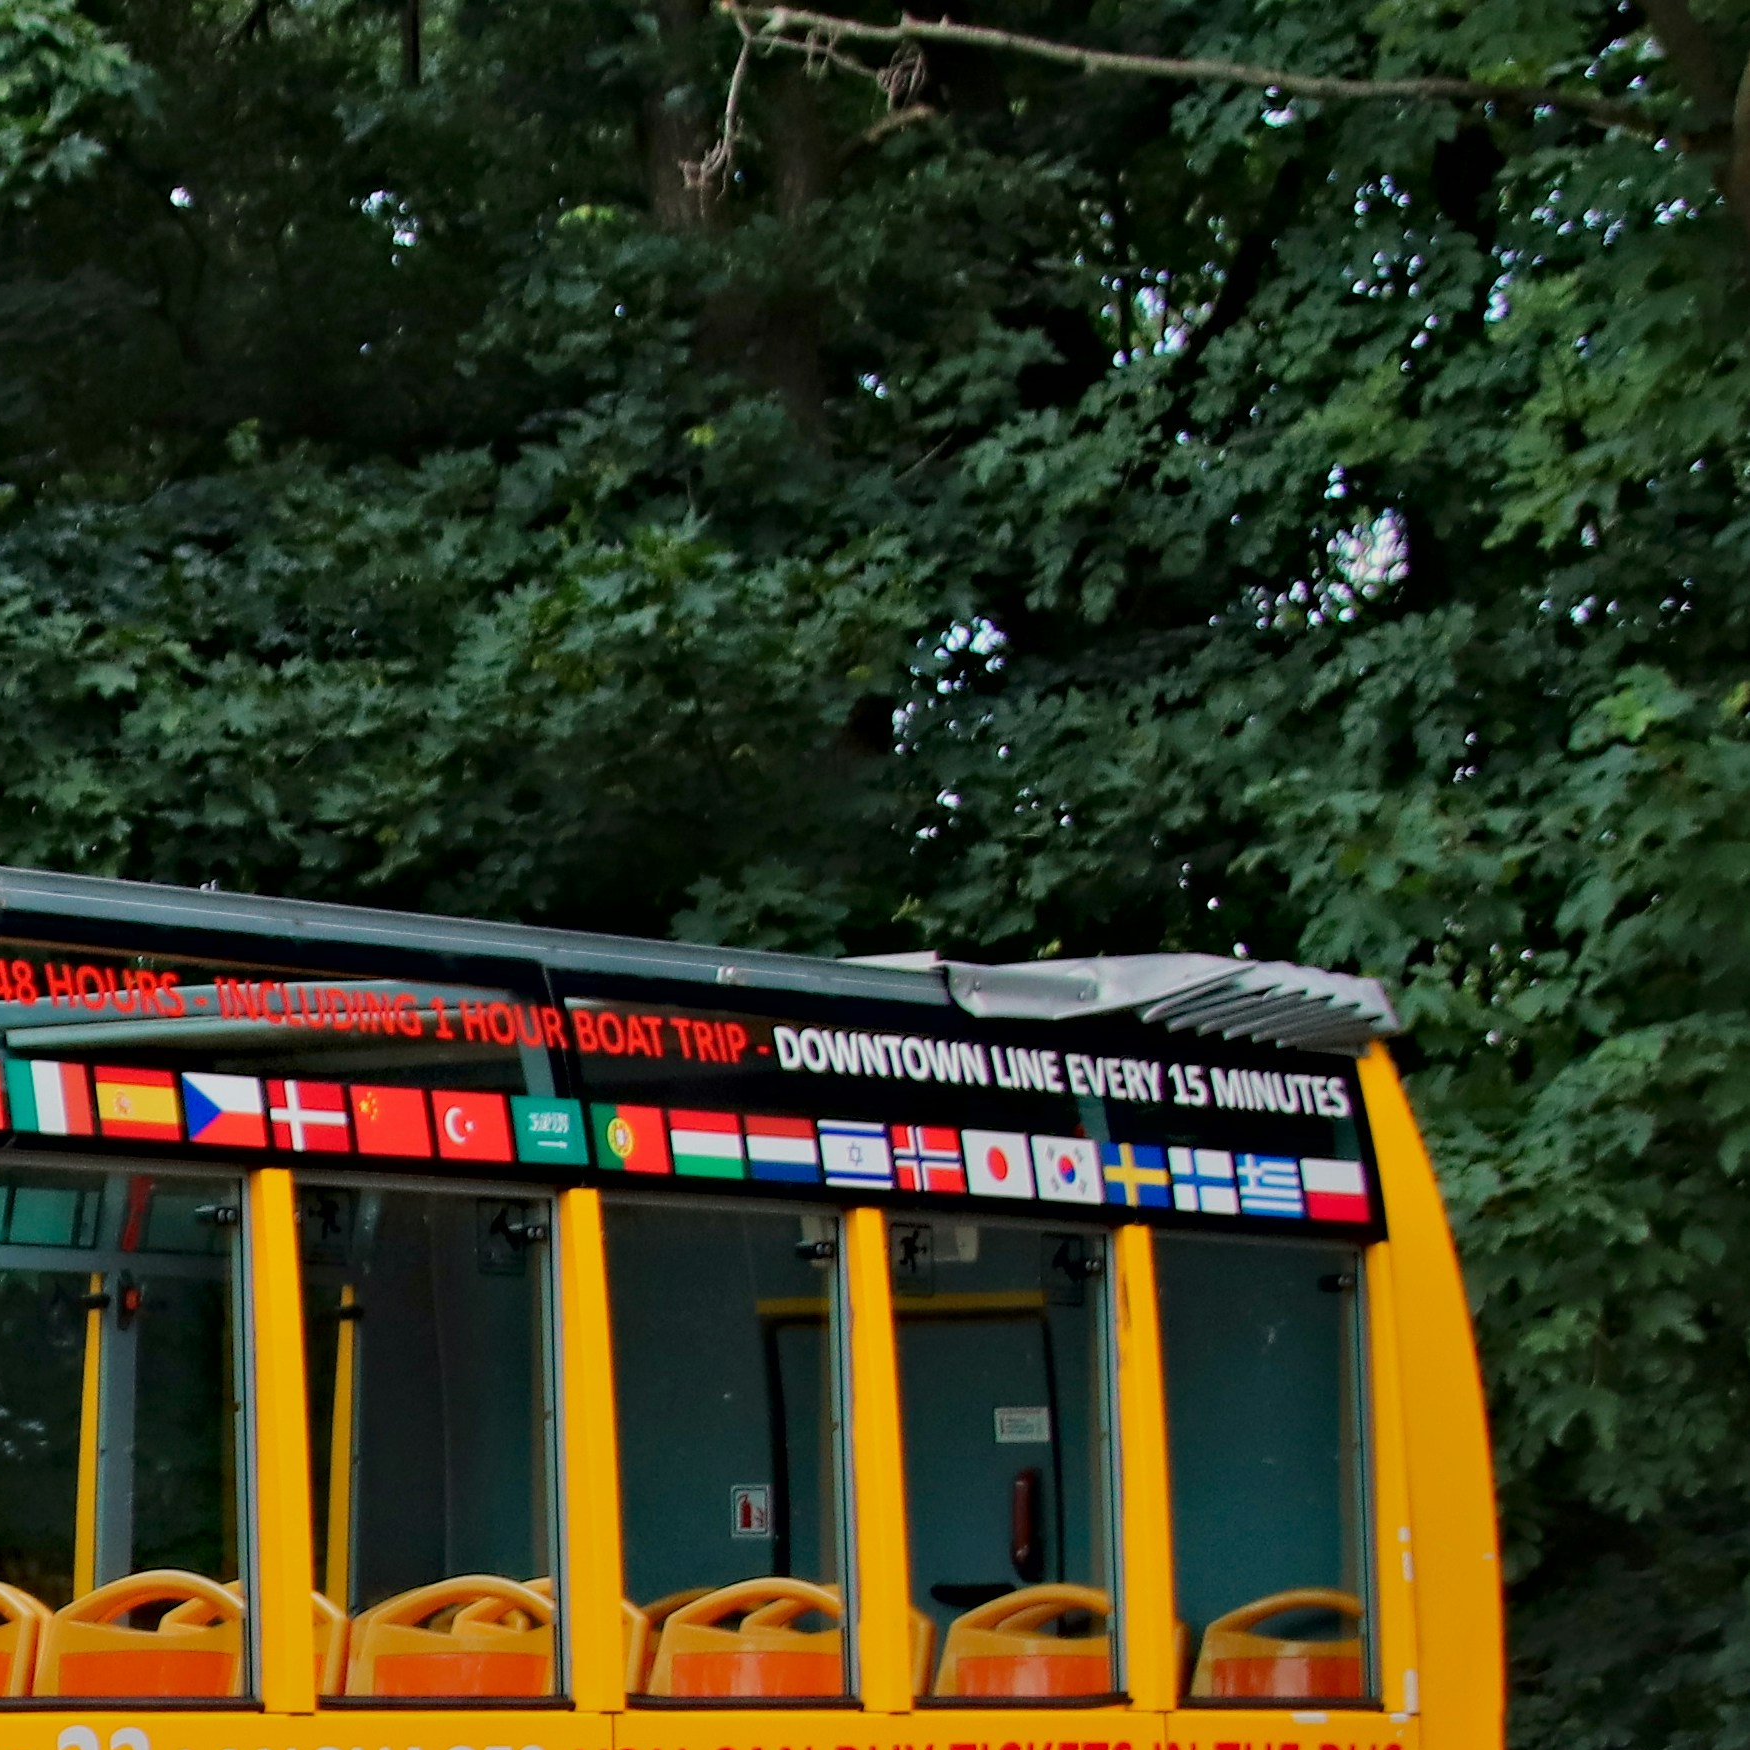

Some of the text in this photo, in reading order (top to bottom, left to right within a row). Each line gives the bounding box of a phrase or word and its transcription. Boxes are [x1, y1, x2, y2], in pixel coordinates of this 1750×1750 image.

[46, 961, 185, 1018] HOURS
[215, 977, 423, 1038] INCLUDING
[431, 998, 452, 1040] 1
[463, 999, 569, 1050] HOUR
[576, 1010, 665, 1059] BOAT
[669, 1019, 747, 1065] TRIP
[771, 1026, 988, 1087] DOWNTOWN
[993, 1044, 1062, 1094] LINE
[1066, 1054, 1161, 1103] EVERY
[1167, 1061, 1209, 1106] 15
[1213, 1067, 1353, 1118] MINUTES
